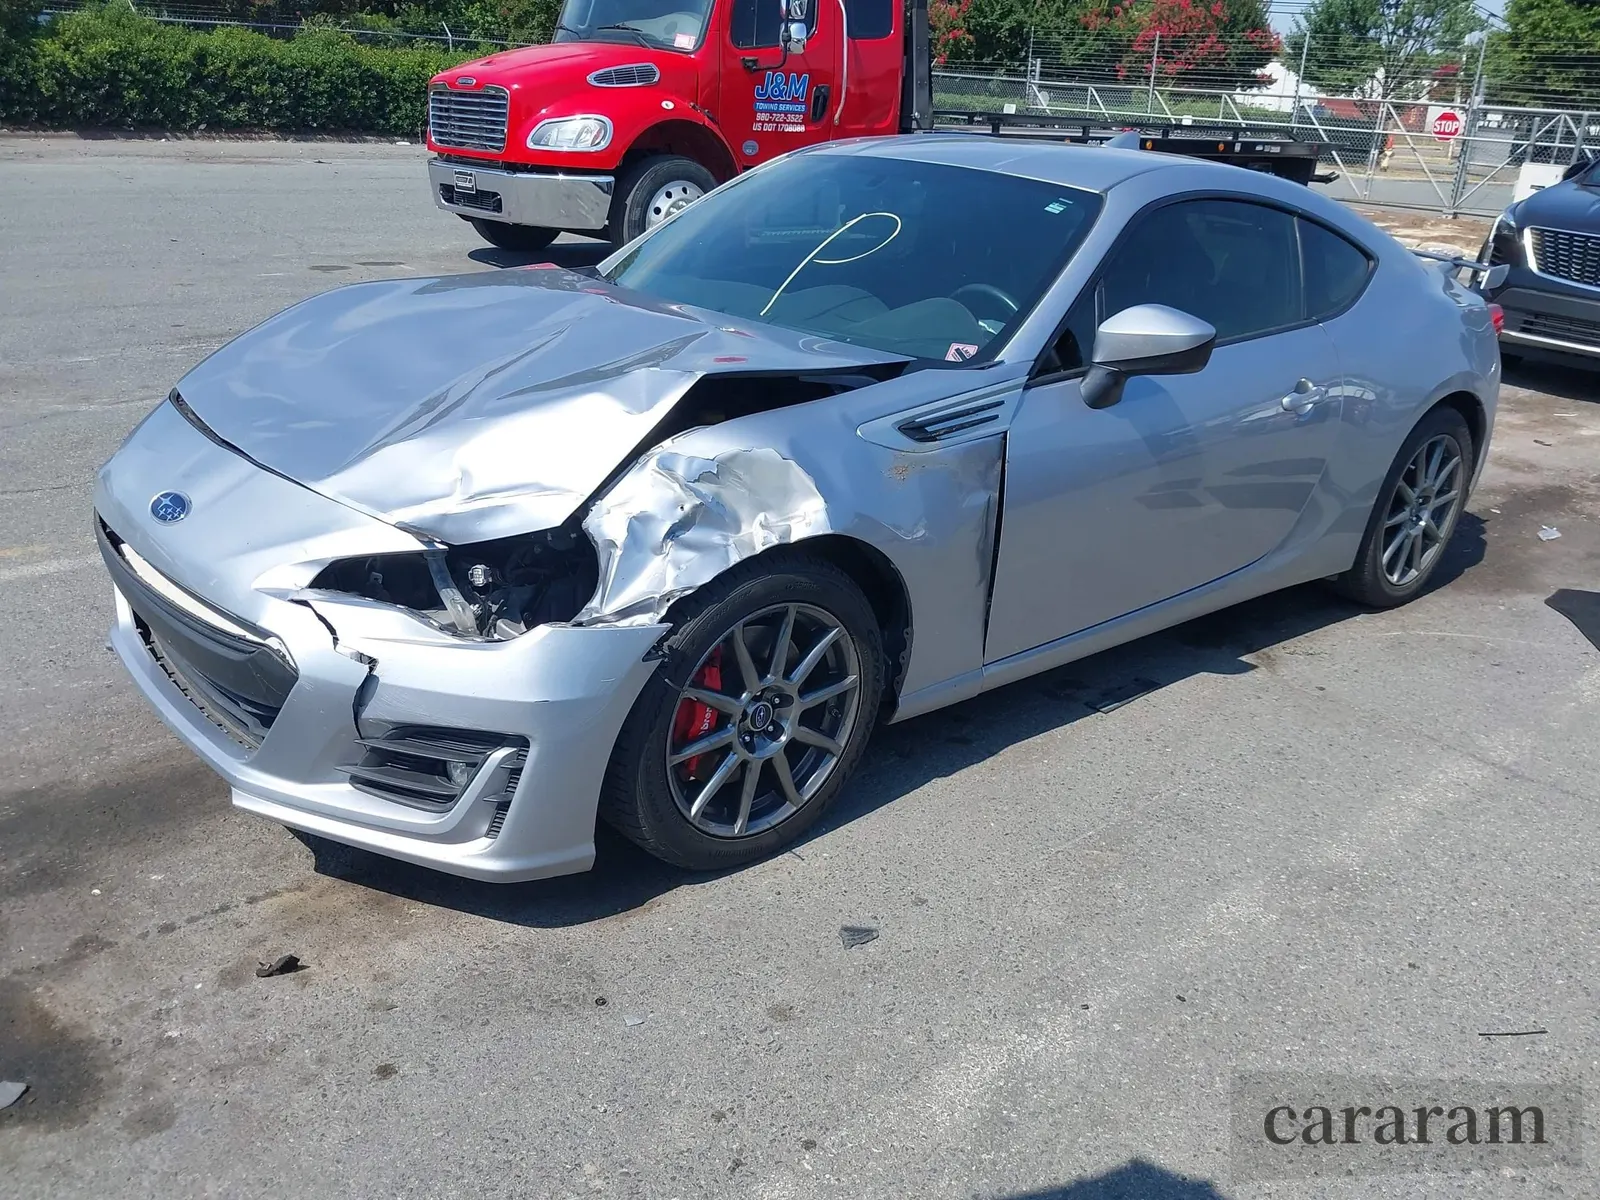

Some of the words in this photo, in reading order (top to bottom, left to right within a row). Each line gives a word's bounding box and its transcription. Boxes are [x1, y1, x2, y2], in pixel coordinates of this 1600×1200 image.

[754, 71, 809, 101] J&M
[755, 102, 778, 111] TOWING
[778, 103, 806, 112] SERVICES
[756, 113, 803, 122] 980-722-3522
[752, 122, 762, 131] US
[763, 123, 777, 132] DOT
[1433, 120, 1460, 133] STOP
